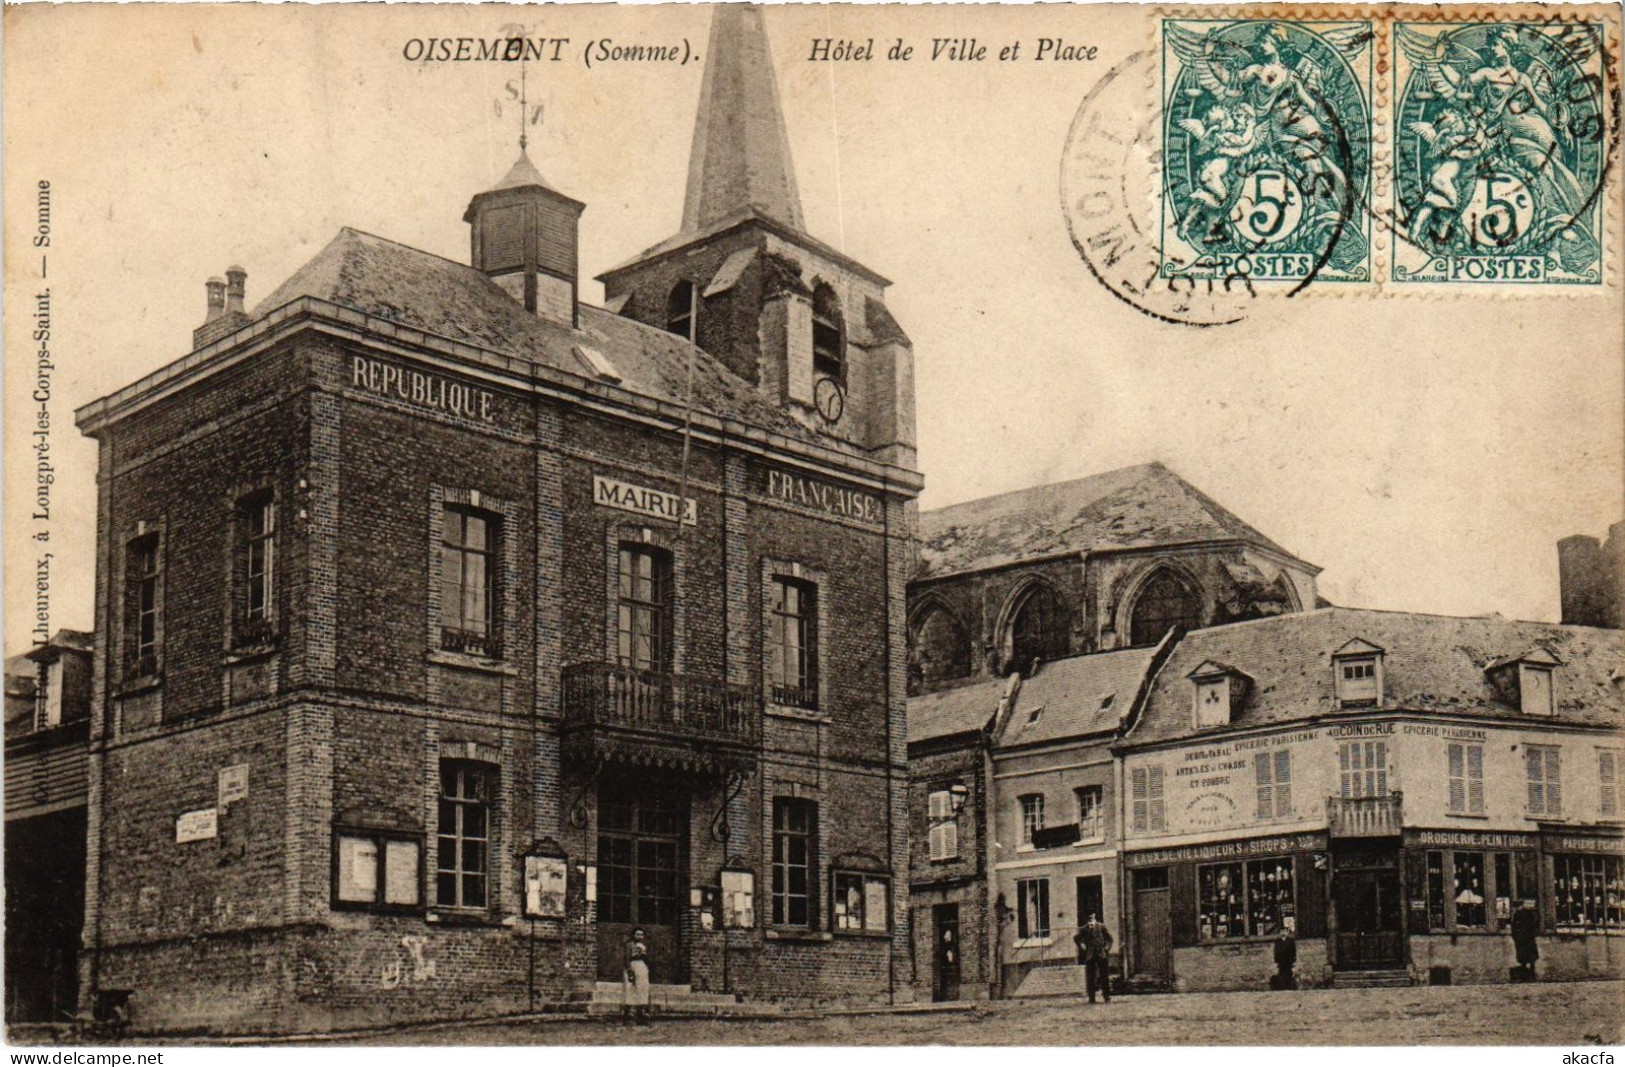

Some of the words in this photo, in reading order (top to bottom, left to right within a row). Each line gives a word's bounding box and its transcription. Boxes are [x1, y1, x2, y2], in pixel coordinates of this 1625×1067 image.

[1219, 256, 1310, 277] POSTES
[1451, 258, 1541, 280] POSTES
[352, 355, 494, 423] REPUBLIQUE
[1340, 724, 1363, 736] COIN
[1375, 722, 1396, 735] RUE
[1250, 838, 1287, 853] SIROPS
[1480, 834, 1528, 847] PEINTURE
